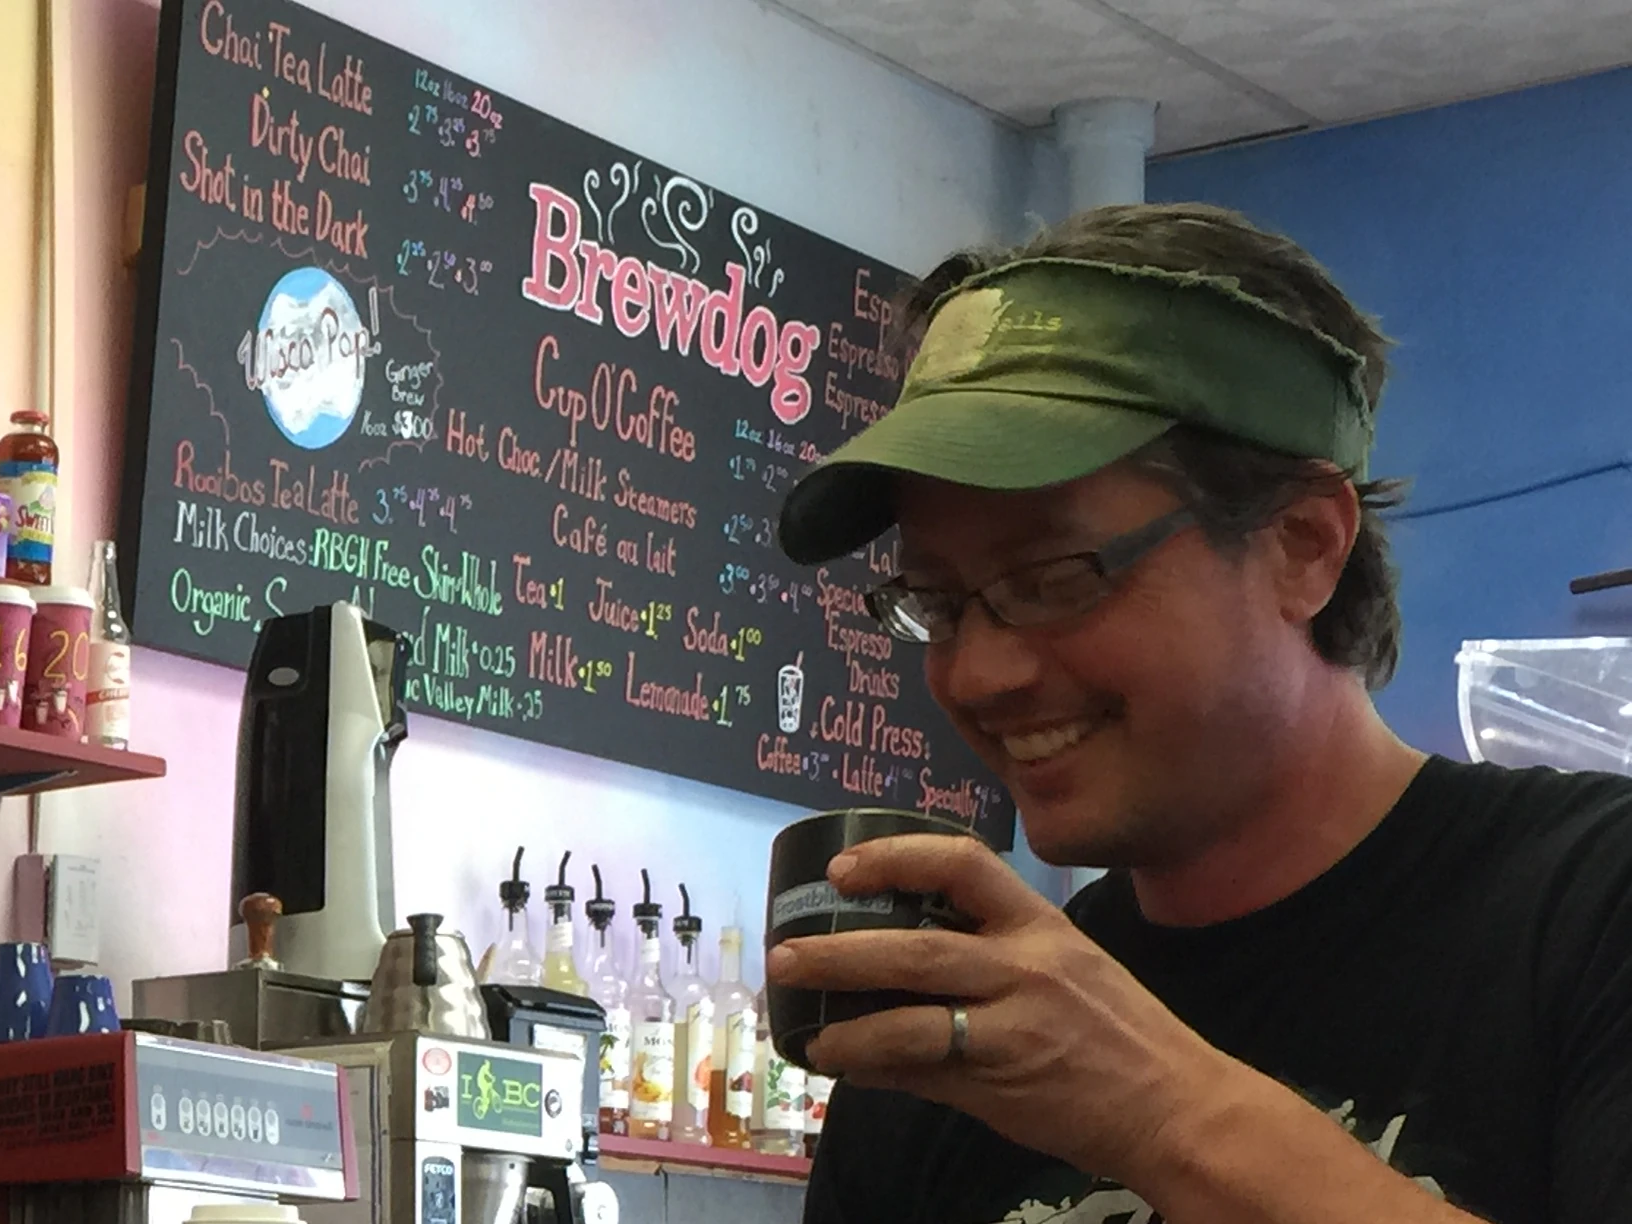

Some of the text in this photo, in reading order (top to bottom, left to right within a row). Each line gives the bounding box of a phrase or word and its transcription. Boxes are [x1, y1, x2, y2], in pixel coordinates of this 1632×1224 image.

[201, 0, 373, 115] Chai Tea Latte
[251, 93, 371, 187] Dirty Chai
[470, 90, 503, 130] 20oz
[180, 130, 369, 259] Shot in the Dark
[521, 181, 821, 425] Brewdog
[384, 357, 434, 390] Ginger
[391, 385, 425, 407] Brew
[534, 334, 588, 448] Cup
[734, 418, 764, 445] 12oz
[173, 440, 266, 507] Rooibos
[269, 458, 306, 510] Tea
[306, 464, 361, 525] Latte
[446, 407, 490, 462] Hot
[613, 467, 698, 529] Steamers
[173, 501, 230, 552] Milk
[371, 539, 411, 589] Free
[551, 502, 678, 577] Café au lait
[170, 567, 252, 637] Organic
[511, 552, 548, 610] Tea
[587, 575, 641, 633] Juice
[682, 605, 730, 657] Soda
[431, 622, 470, 680] Milk
[826, 610, 895, 667] Espresso
[422, 672, 476, 721] Valley
[476, 684, 516, 719] Milk
[527, 630, 580, 690] Milk
[624, 650, 711, 722] Lemonade
[848, 658, 903, 701] Drinks
[820, 694, 866, 749] Cold
[756, 732, 804, 776] Coffee
[840, 752, 885, 798] Latte
